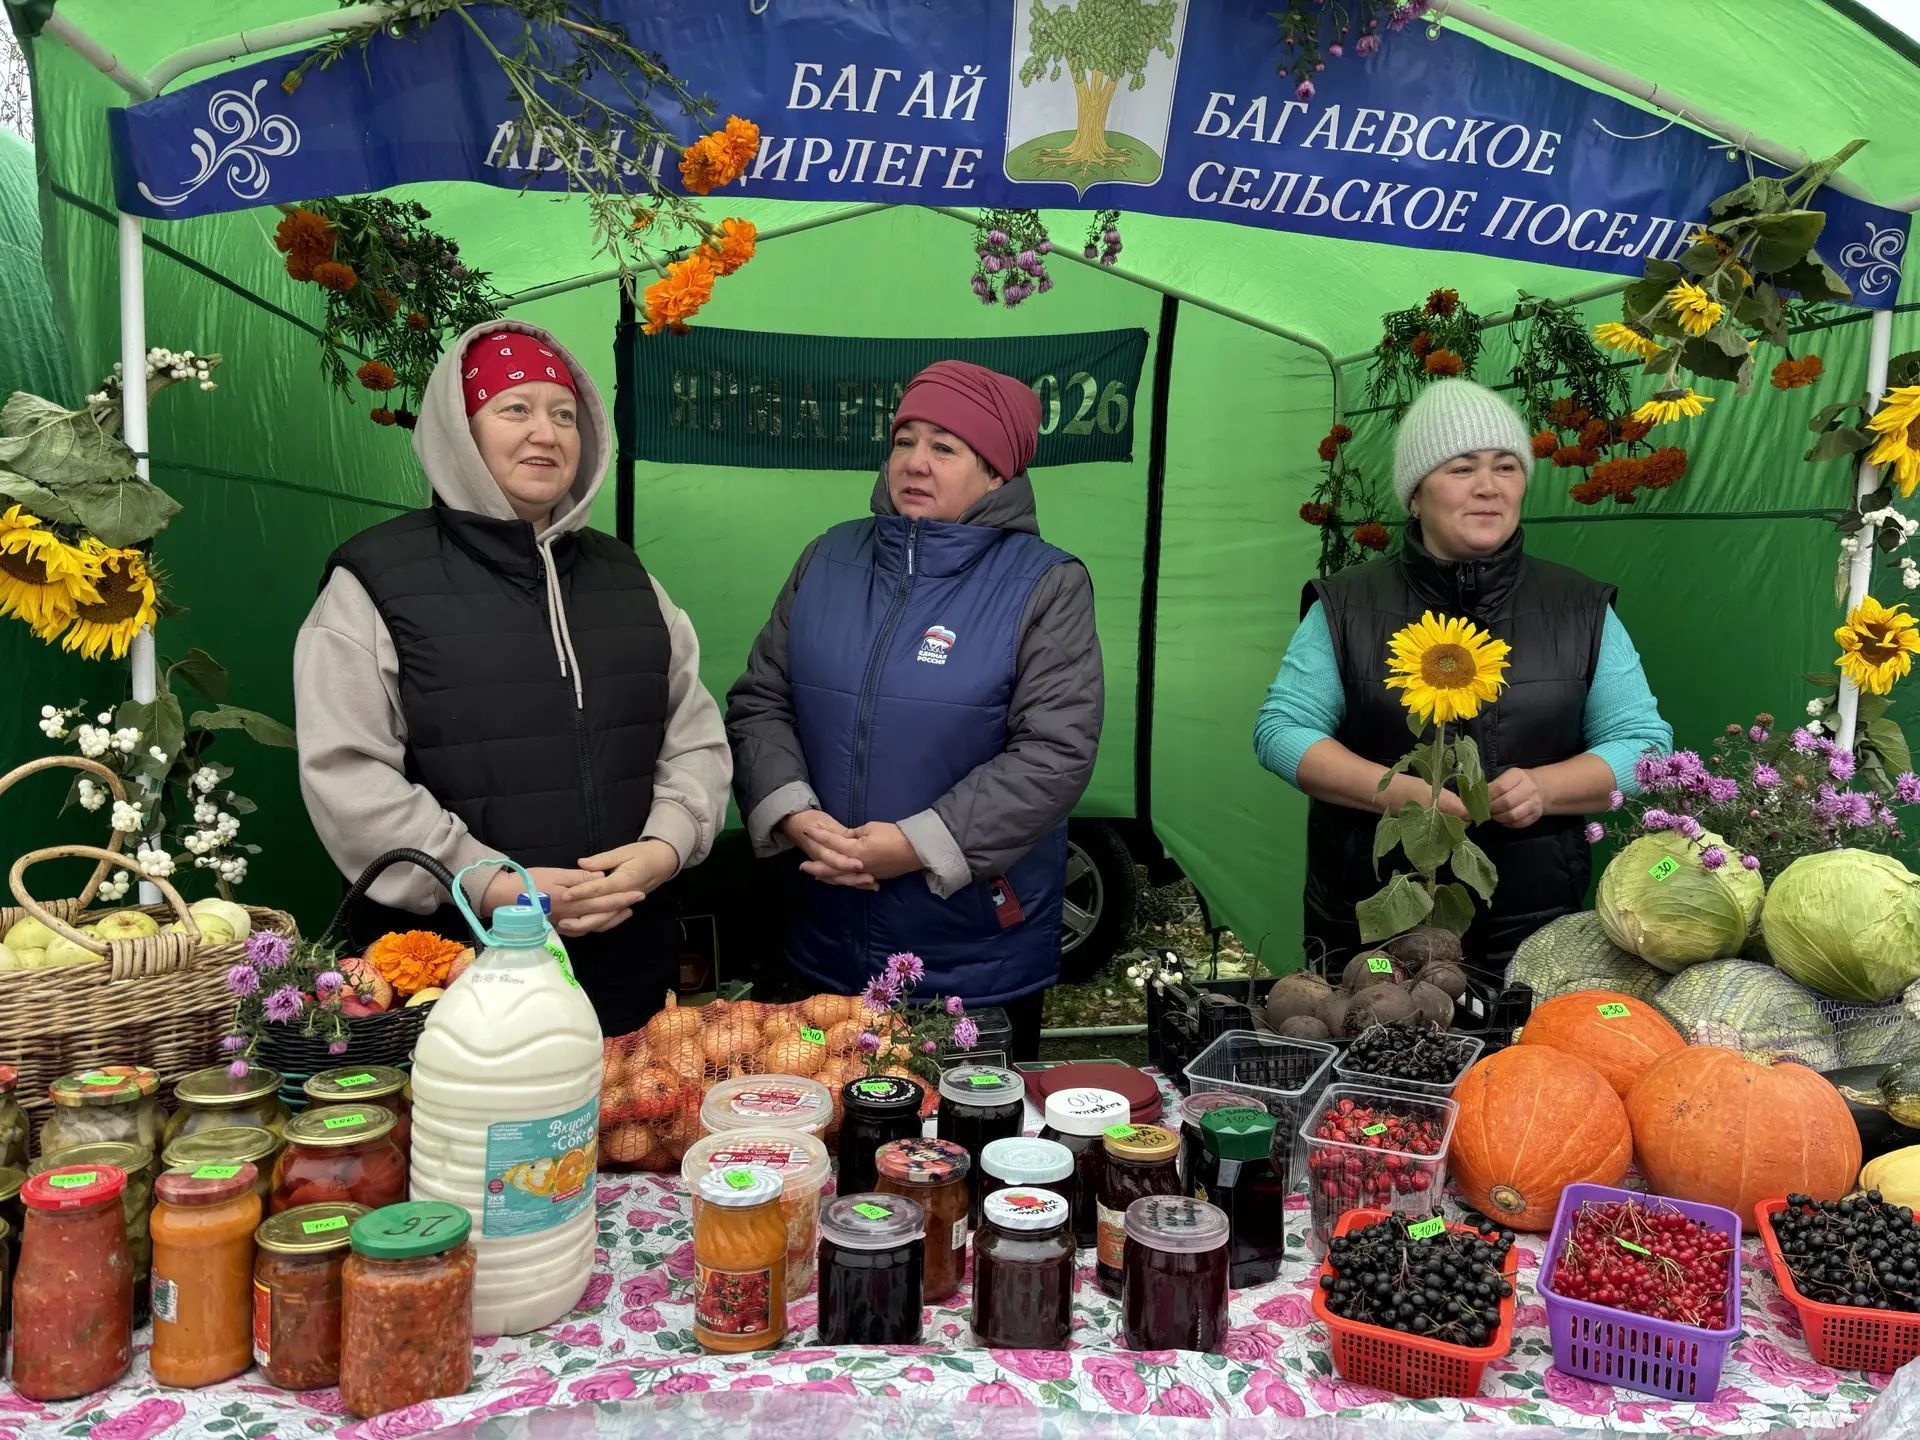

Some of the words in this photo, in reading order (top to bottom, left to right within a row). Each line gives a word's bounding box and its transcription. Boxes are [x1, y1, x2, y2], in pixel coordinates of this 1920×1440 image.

[786, 62, 986, 121] БАГАЙ
[722, 134, 984, 190] ИРЛЕГЕ
[1192, 91, 1561, 176] БАГАЕВСКОЕ
[1187, 160, 1477, 234] СЕЛЬСКОЕ
[917, 656, 946, 665] РОССИЯ
